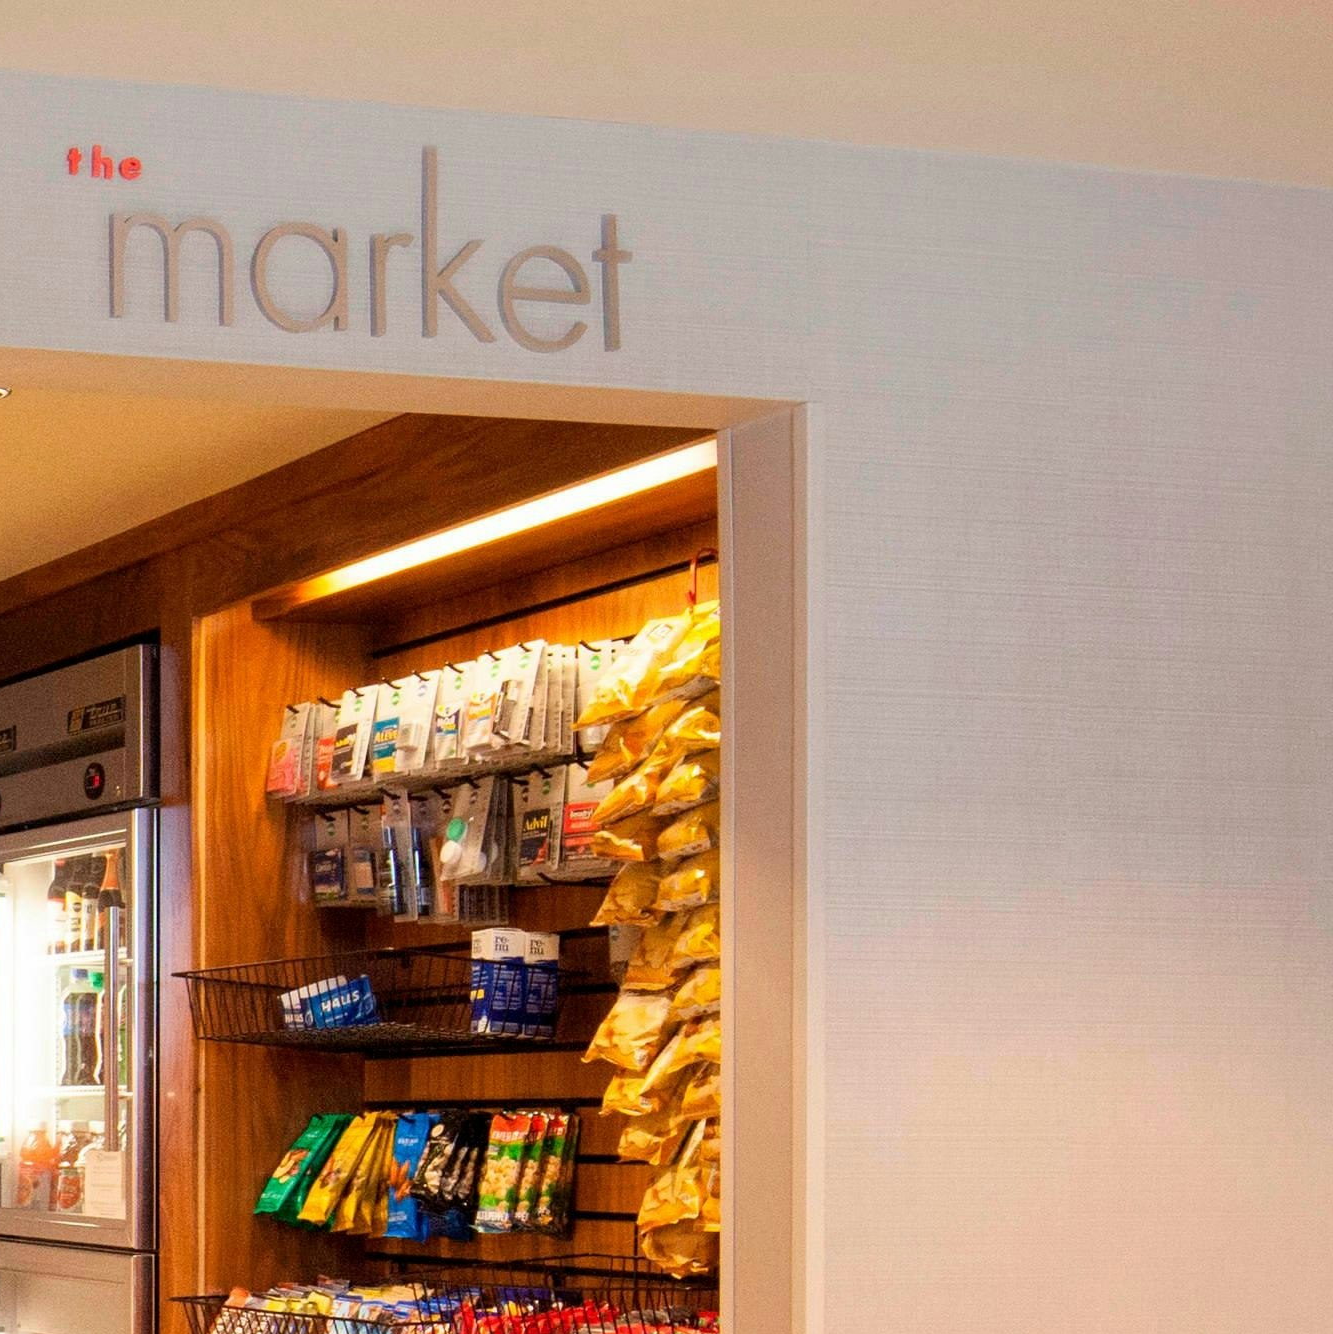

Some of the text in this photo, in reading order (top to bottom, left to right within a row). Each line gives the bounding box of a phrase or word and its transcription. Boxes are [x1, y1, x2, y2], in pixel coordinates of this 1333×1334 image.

[66, 144, 142, 181] the
[109, 145, 632, 354] market
[523, 815, 549, 832] Advil
[321, 990, 360, 1012] HALLS
